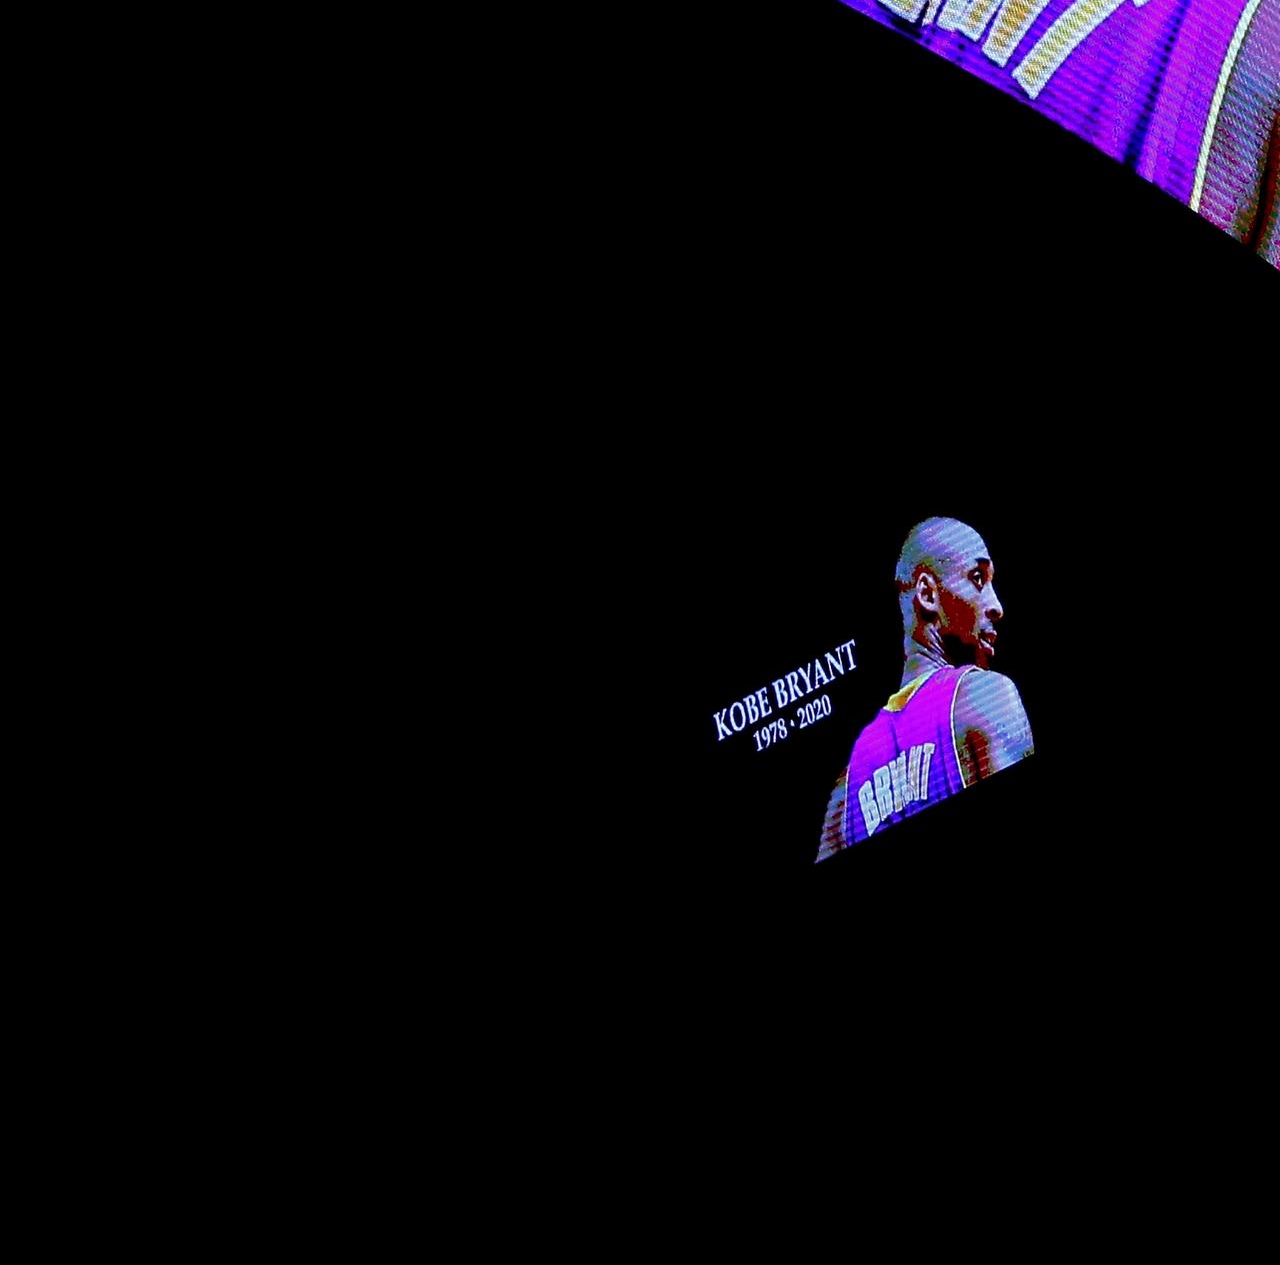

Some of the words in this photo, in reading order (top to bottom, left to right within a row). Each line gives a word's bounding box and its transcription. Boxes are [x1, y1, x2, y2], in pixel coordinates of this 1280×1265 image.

[713, 687, 772, 741] KOBE
[772, 639, 857, 709] BRYANT
[753, 718, 788, 752] 1978
[797, 694, 832, 729] 2020
